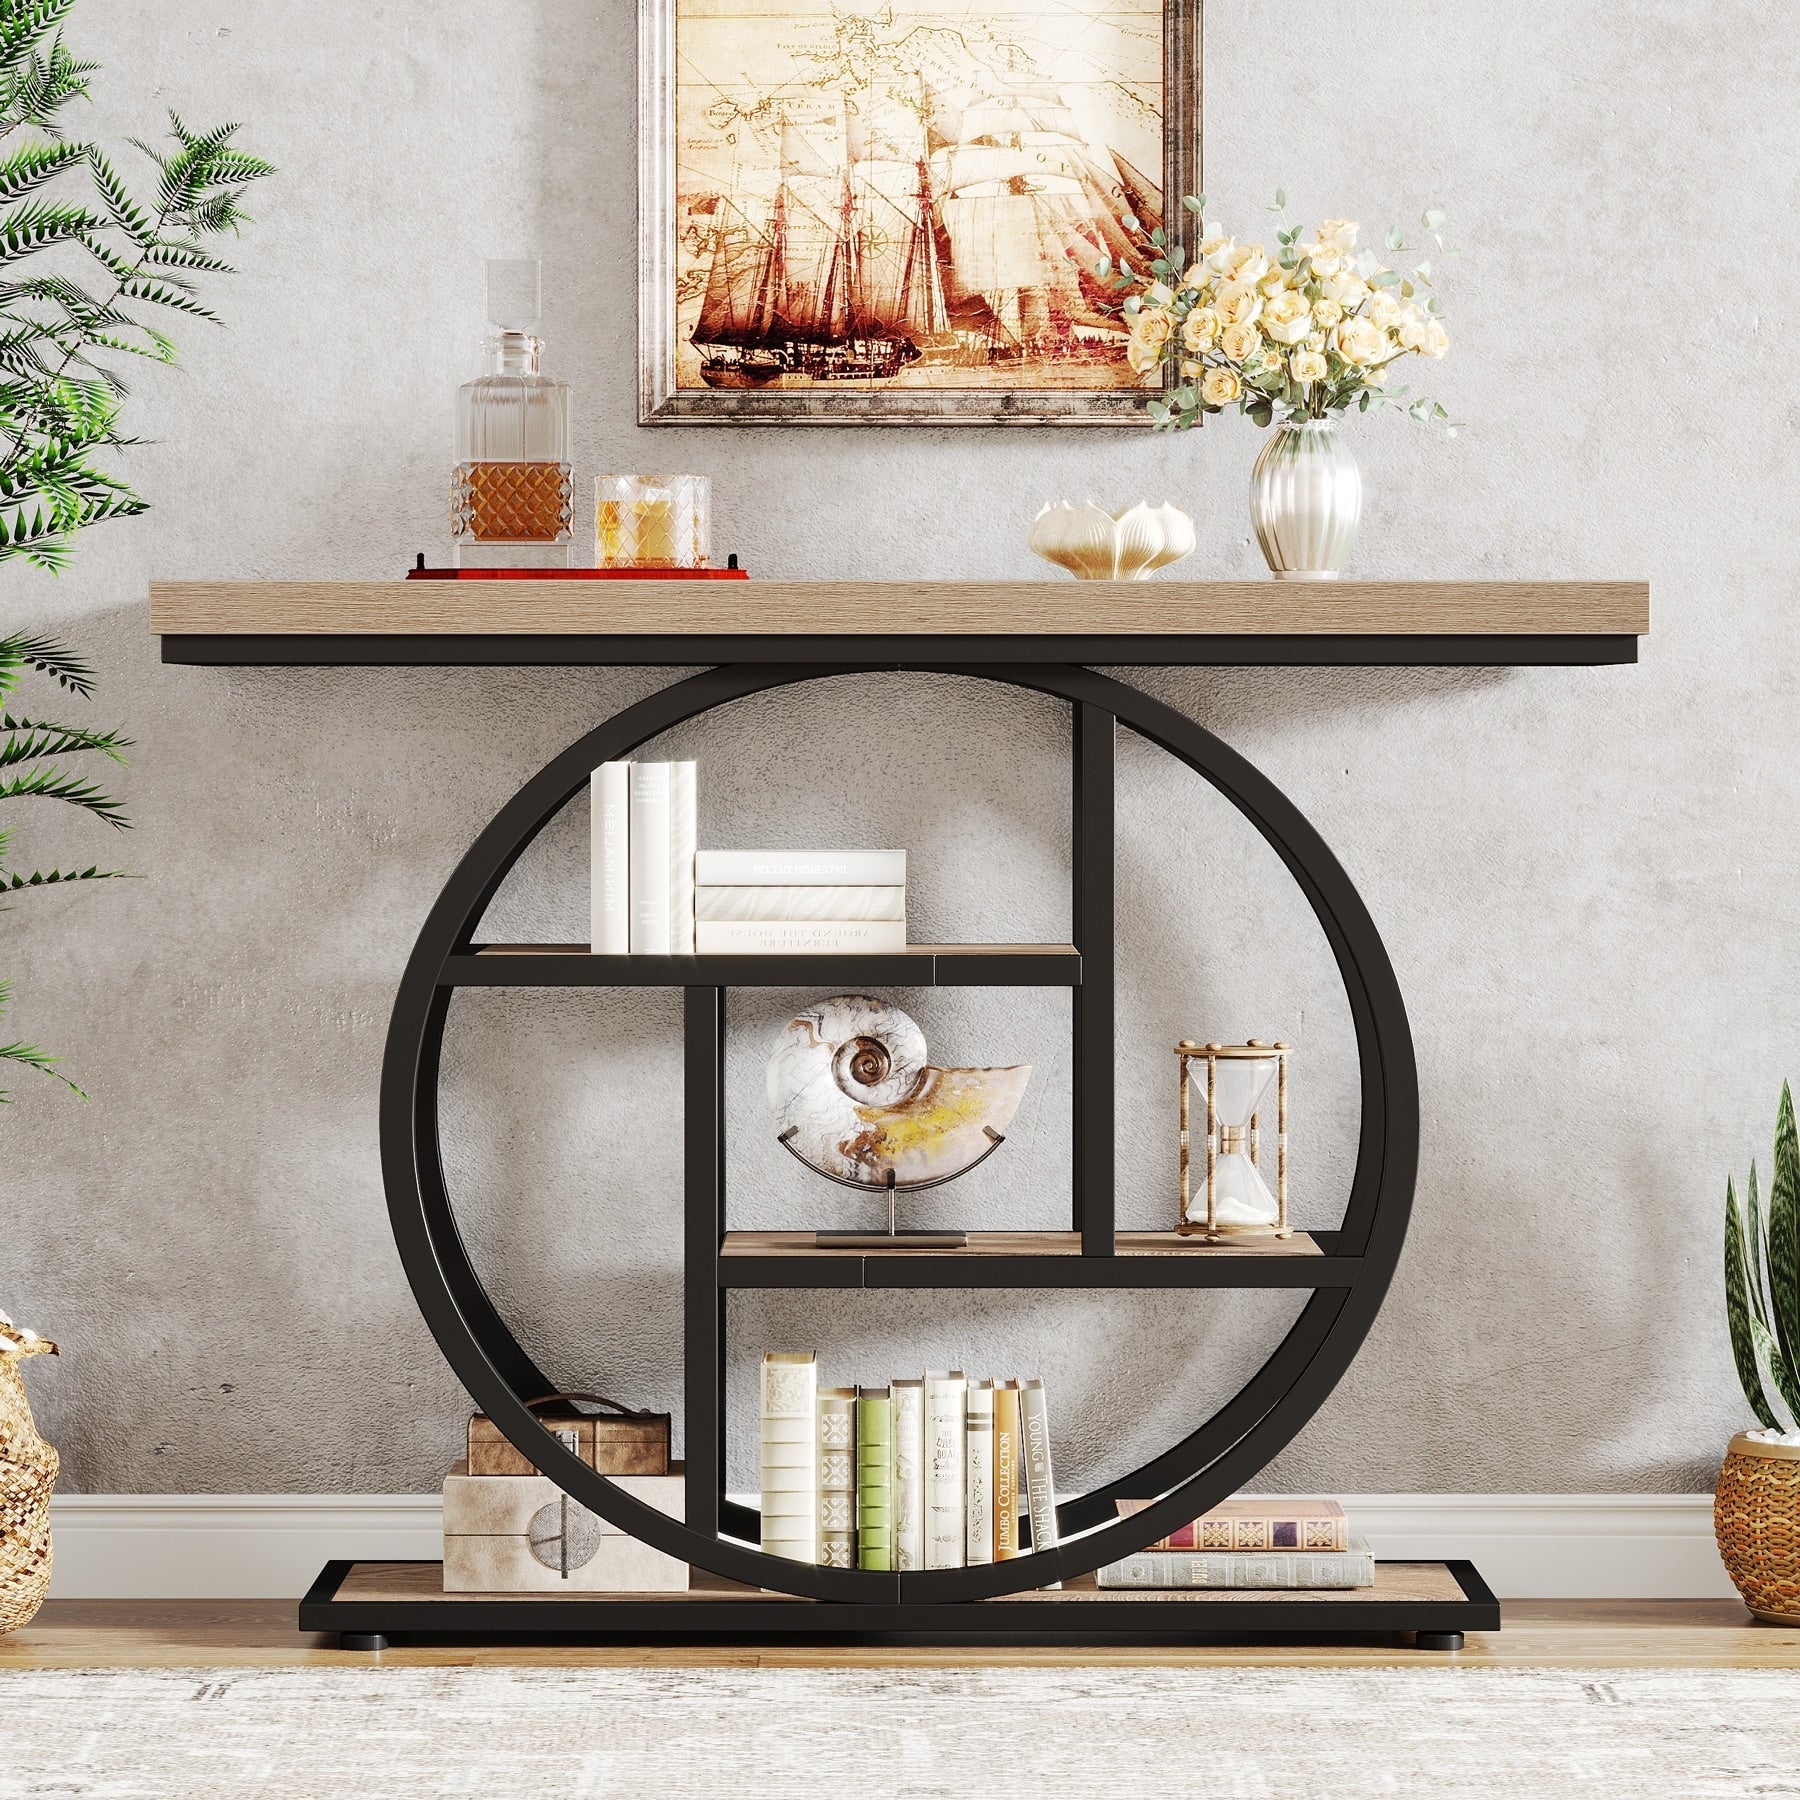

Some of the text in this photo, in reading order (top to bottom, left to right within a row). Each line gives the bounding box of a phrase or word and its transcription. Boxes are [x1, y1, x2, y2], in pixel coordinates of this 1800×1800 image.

[998, 1431, 1013, 1551] JUMBO COLLECTION
[1028, 1412, 1052, 1552] YOUNG THE SHACK
